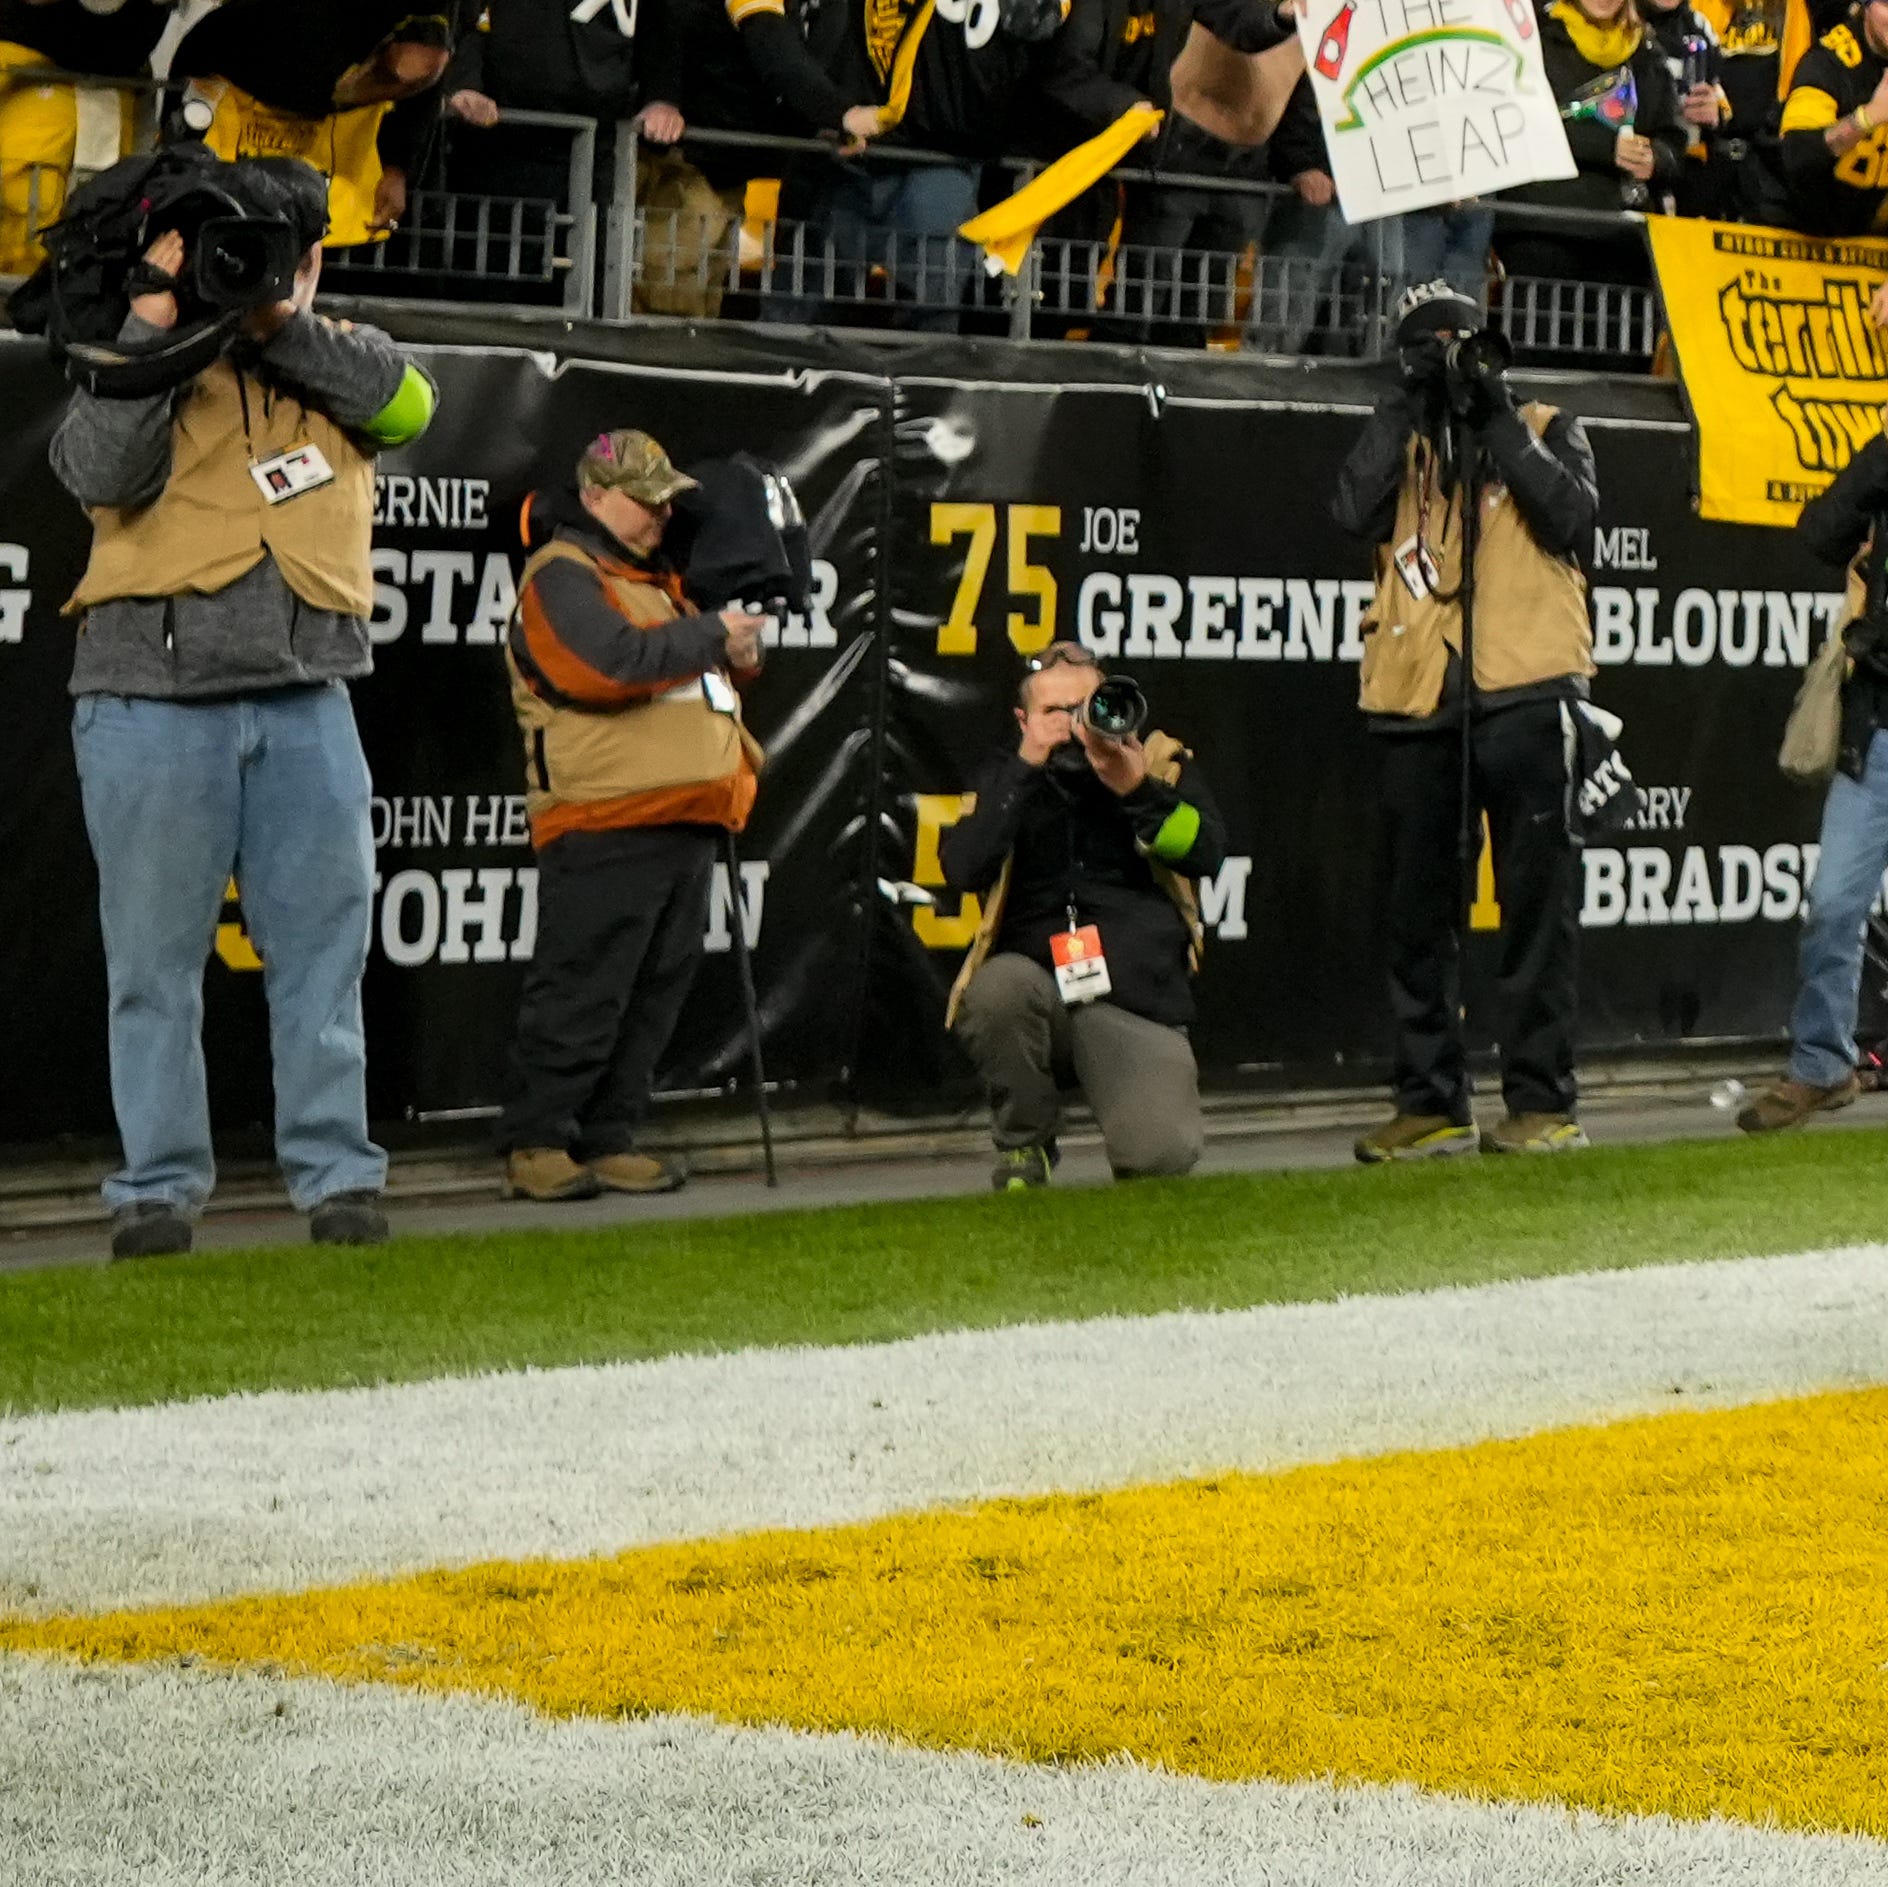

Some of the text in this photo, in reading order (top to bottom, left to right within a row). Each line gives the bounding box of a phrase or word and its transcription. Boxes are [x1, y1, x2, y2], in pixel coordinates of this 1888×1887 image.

[1363, 46, 1511, 119] HEINZ
[1369, 102, 1526, 193] LEAP
[1080, 507, 1140, 554] JOE
[1593, 527, 1657, 571] MEL
[930, 503, 1062, 656] 75
